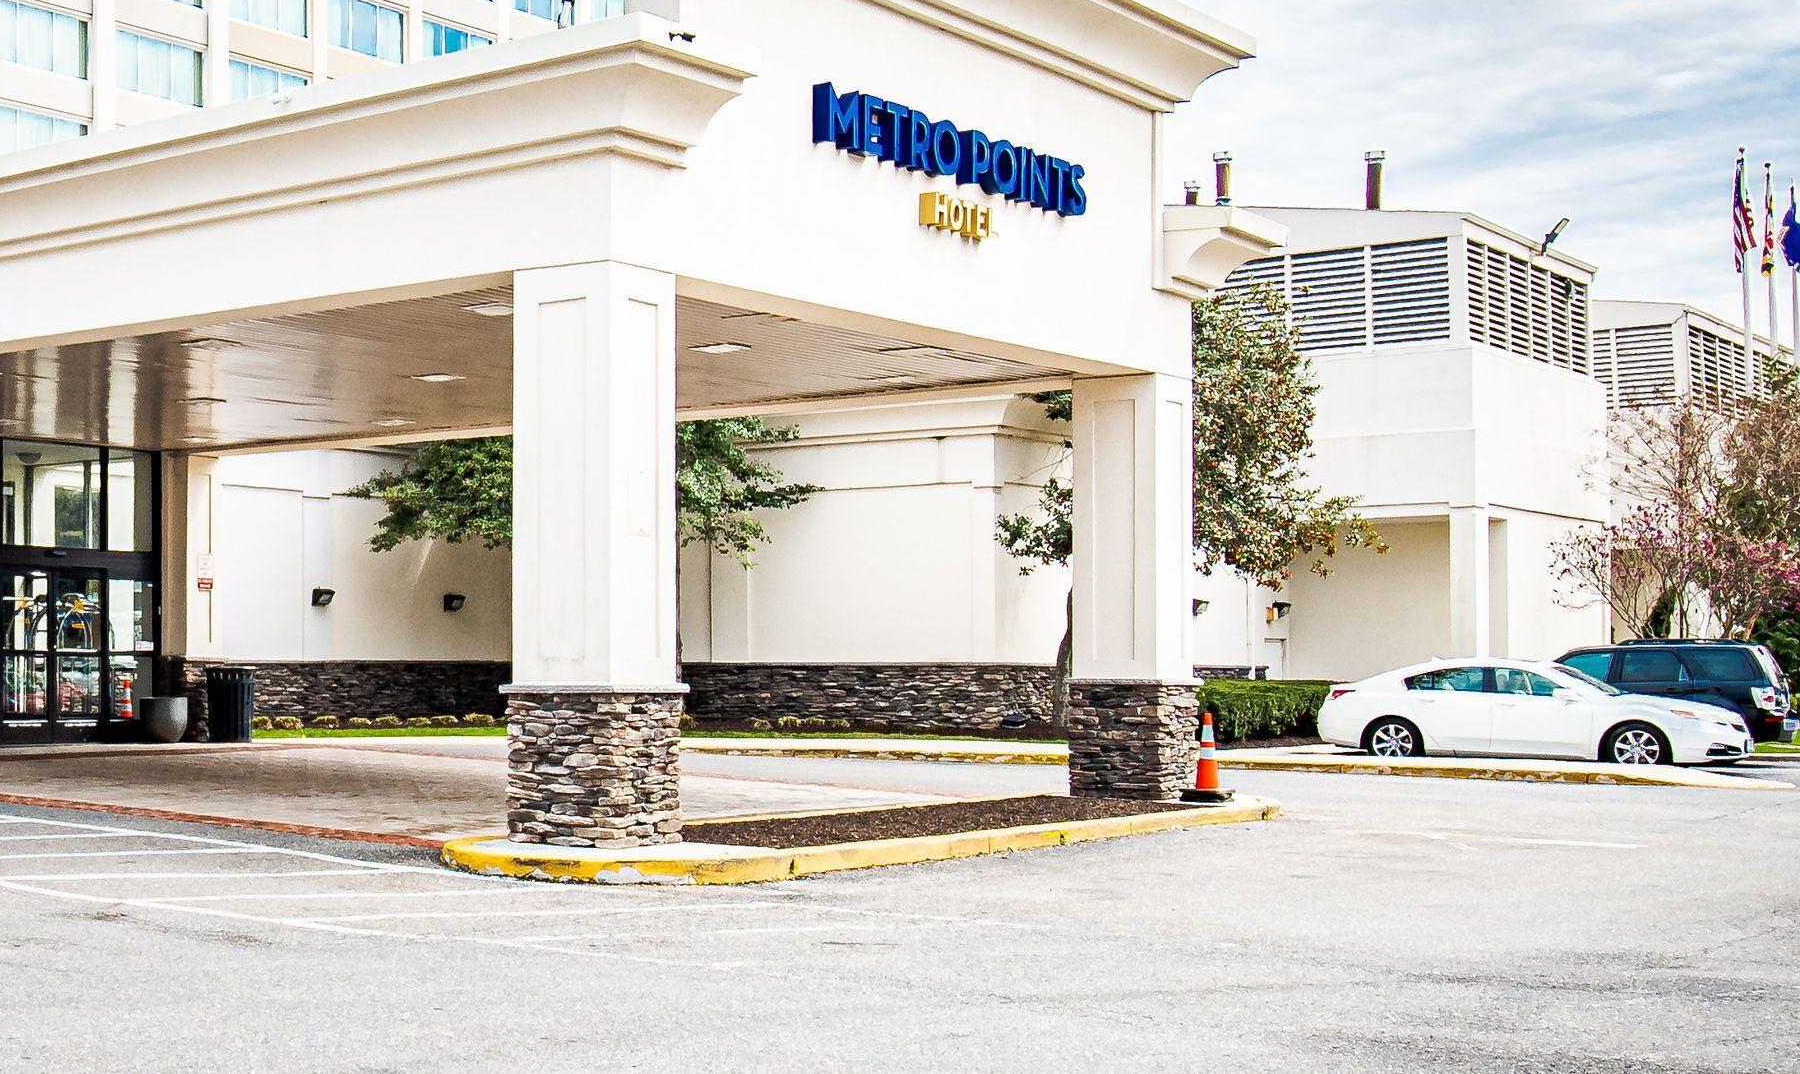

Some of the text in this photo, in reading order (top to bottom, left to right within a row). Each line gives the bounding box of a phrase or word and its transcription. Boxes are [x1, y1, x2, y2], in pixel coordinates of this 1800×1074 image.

[813, 82, 1087, 216] METRO POINTS
[919, 191, 998, 239] HOTEL
